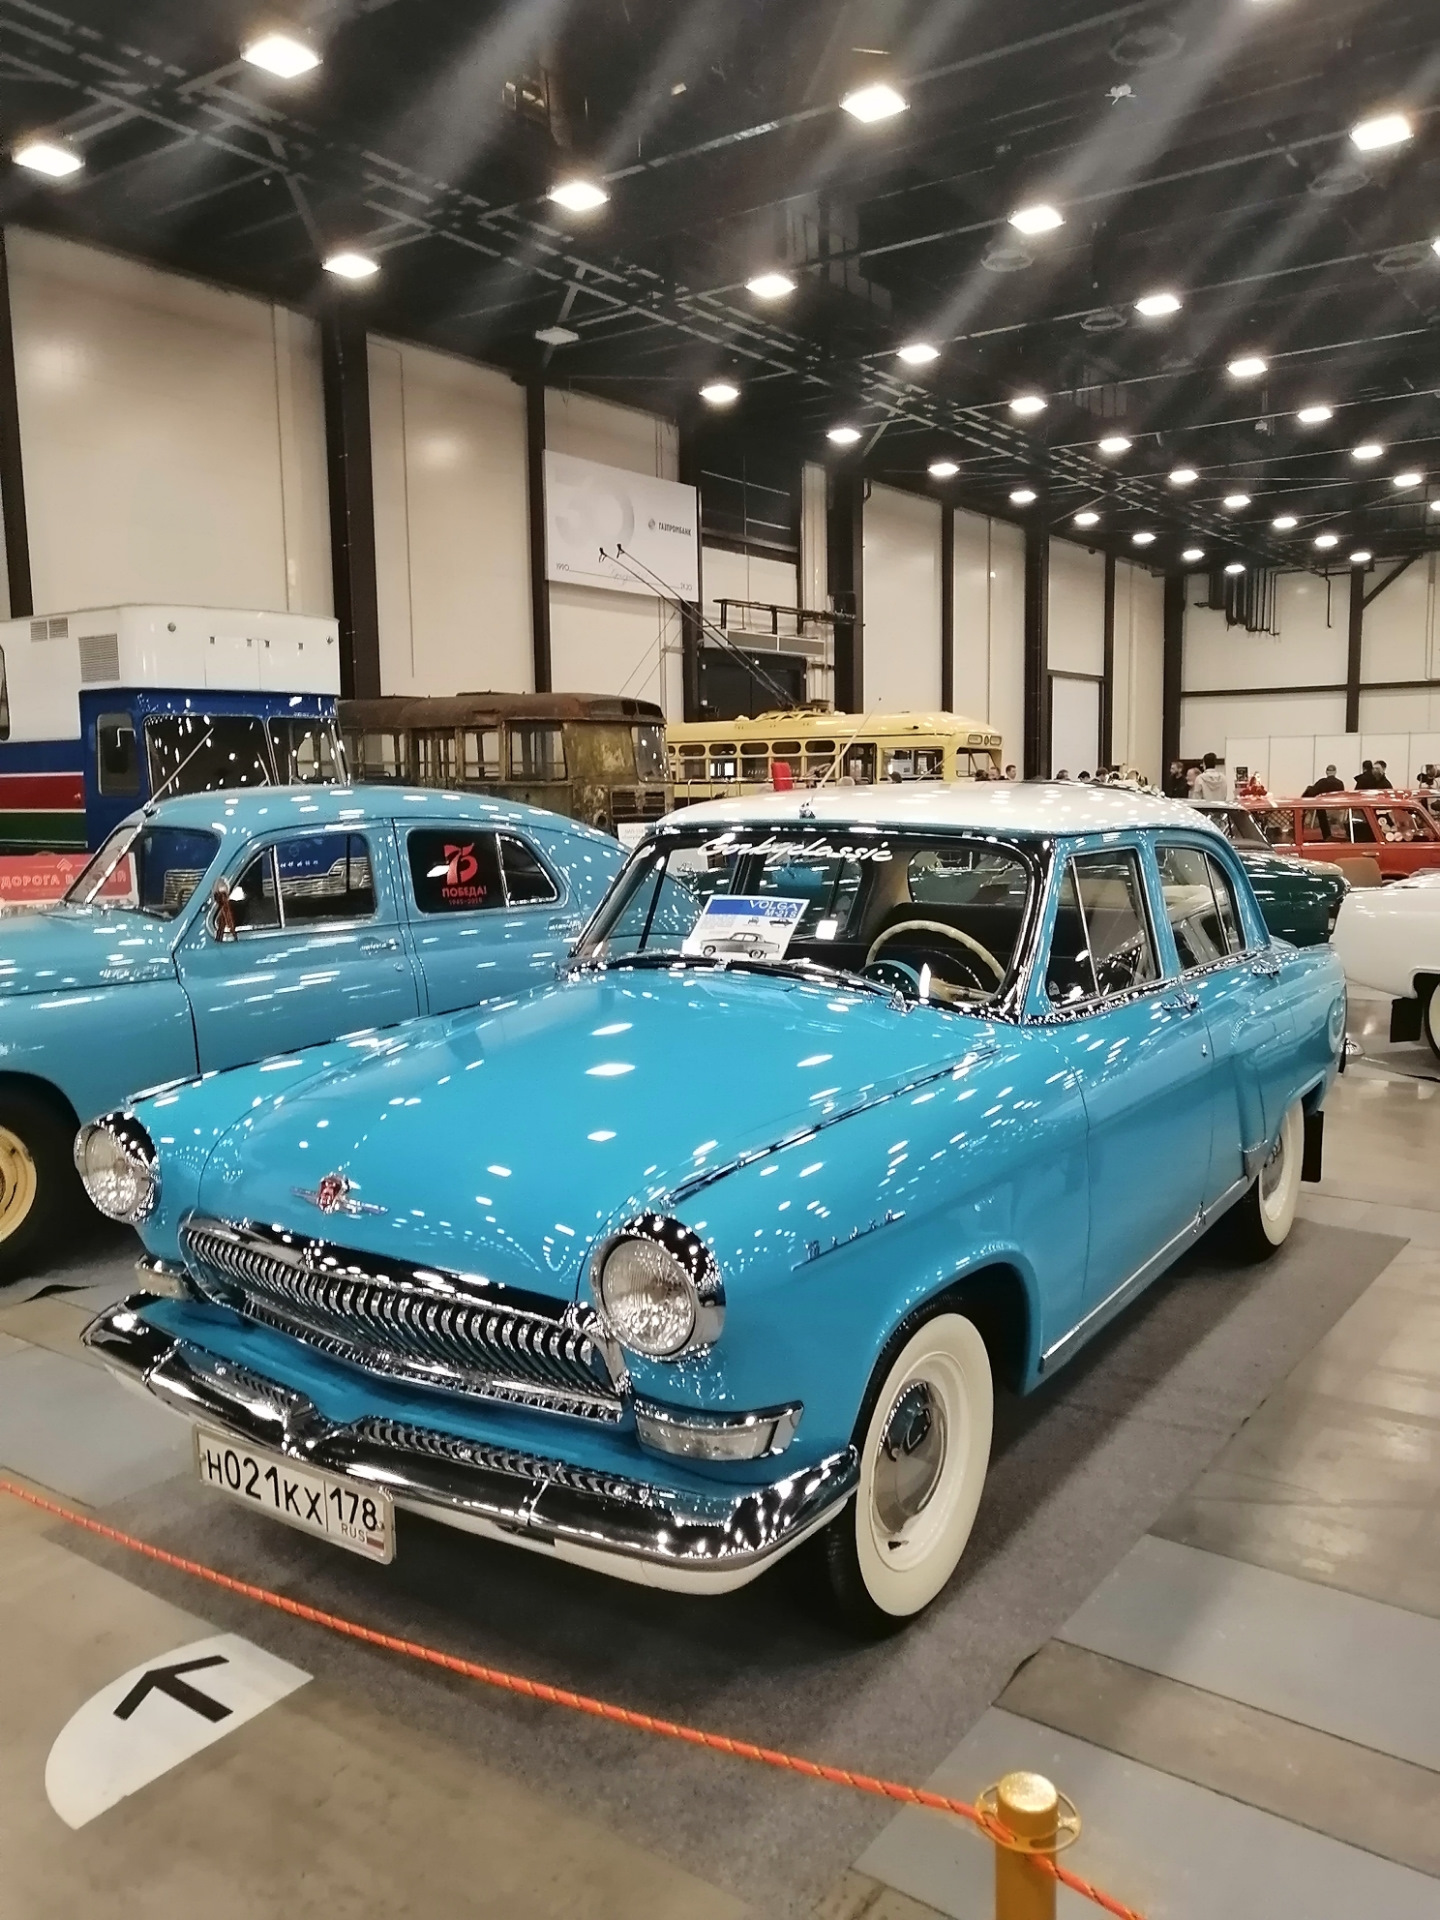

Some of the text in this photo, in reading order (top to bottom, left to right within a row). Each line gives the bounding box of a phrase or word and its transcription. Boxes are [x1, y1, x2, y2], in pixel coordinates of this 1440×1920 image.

[658, 521, 692, 536] ГАЗПРОМБАНК
[443, 842, 478, 886] 75
[0, 874, 60, 889] ДОРОГА
[441, 885, 487, 899] ПОБЕДА!
[749, 899, 798, 911] VOLGA
[207, 1449, 378, 1533] Н021КХ 178
[340, 1522, 367, 1543] RUS
